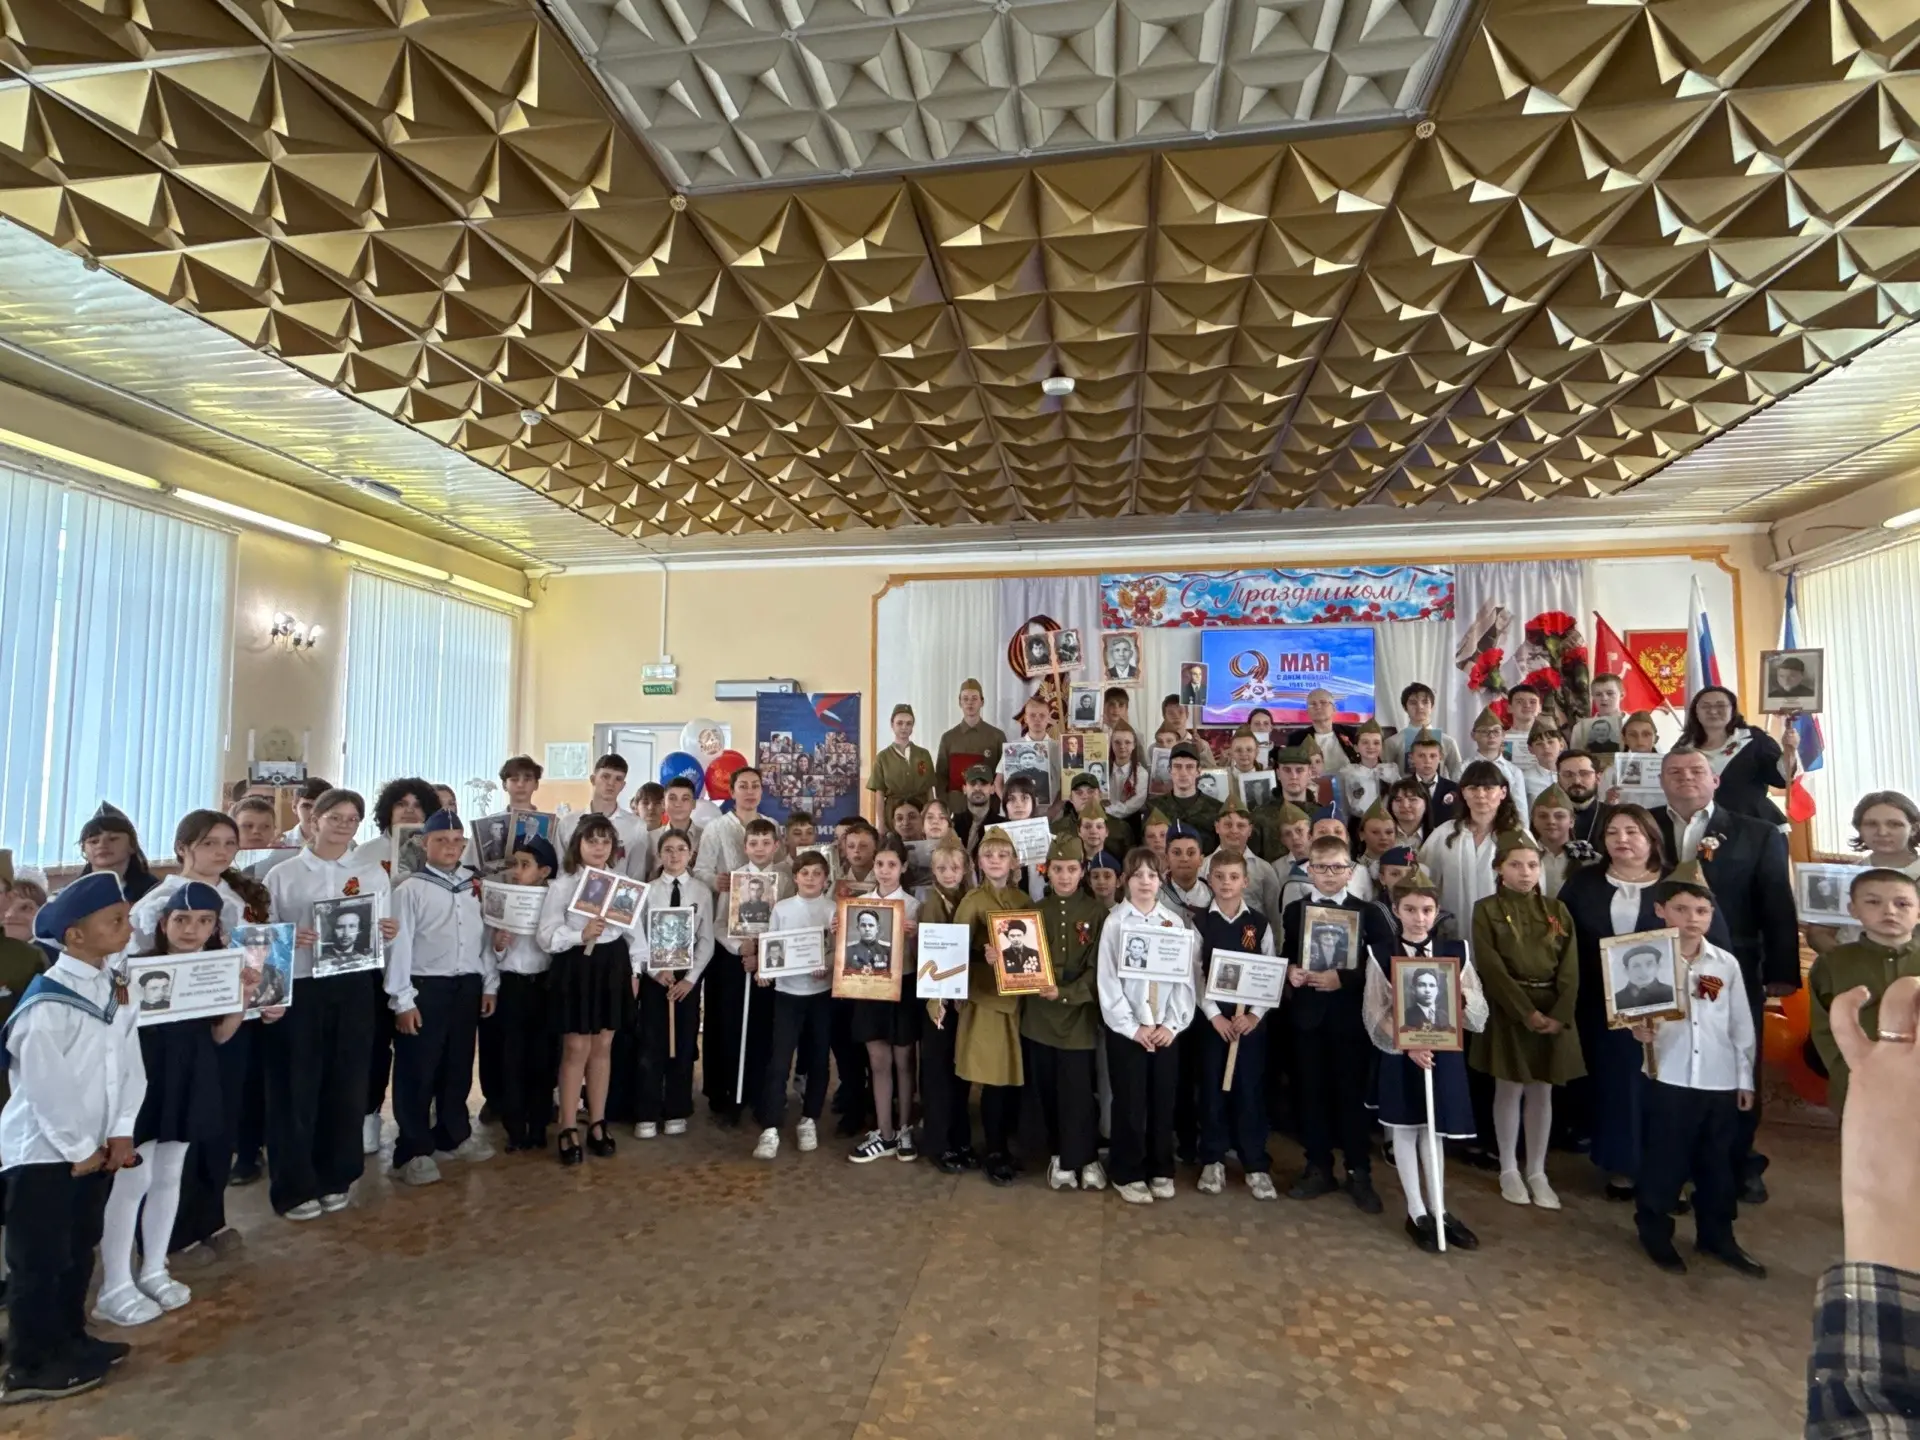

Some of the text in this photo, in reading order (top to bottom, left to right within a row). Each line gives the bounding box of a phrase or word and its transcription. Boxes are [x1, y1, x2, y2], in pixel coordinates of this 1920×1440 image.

[1180, 573, 1417, 611] С Праздником!
[1280, 653, 1330, 672] МАЯ
